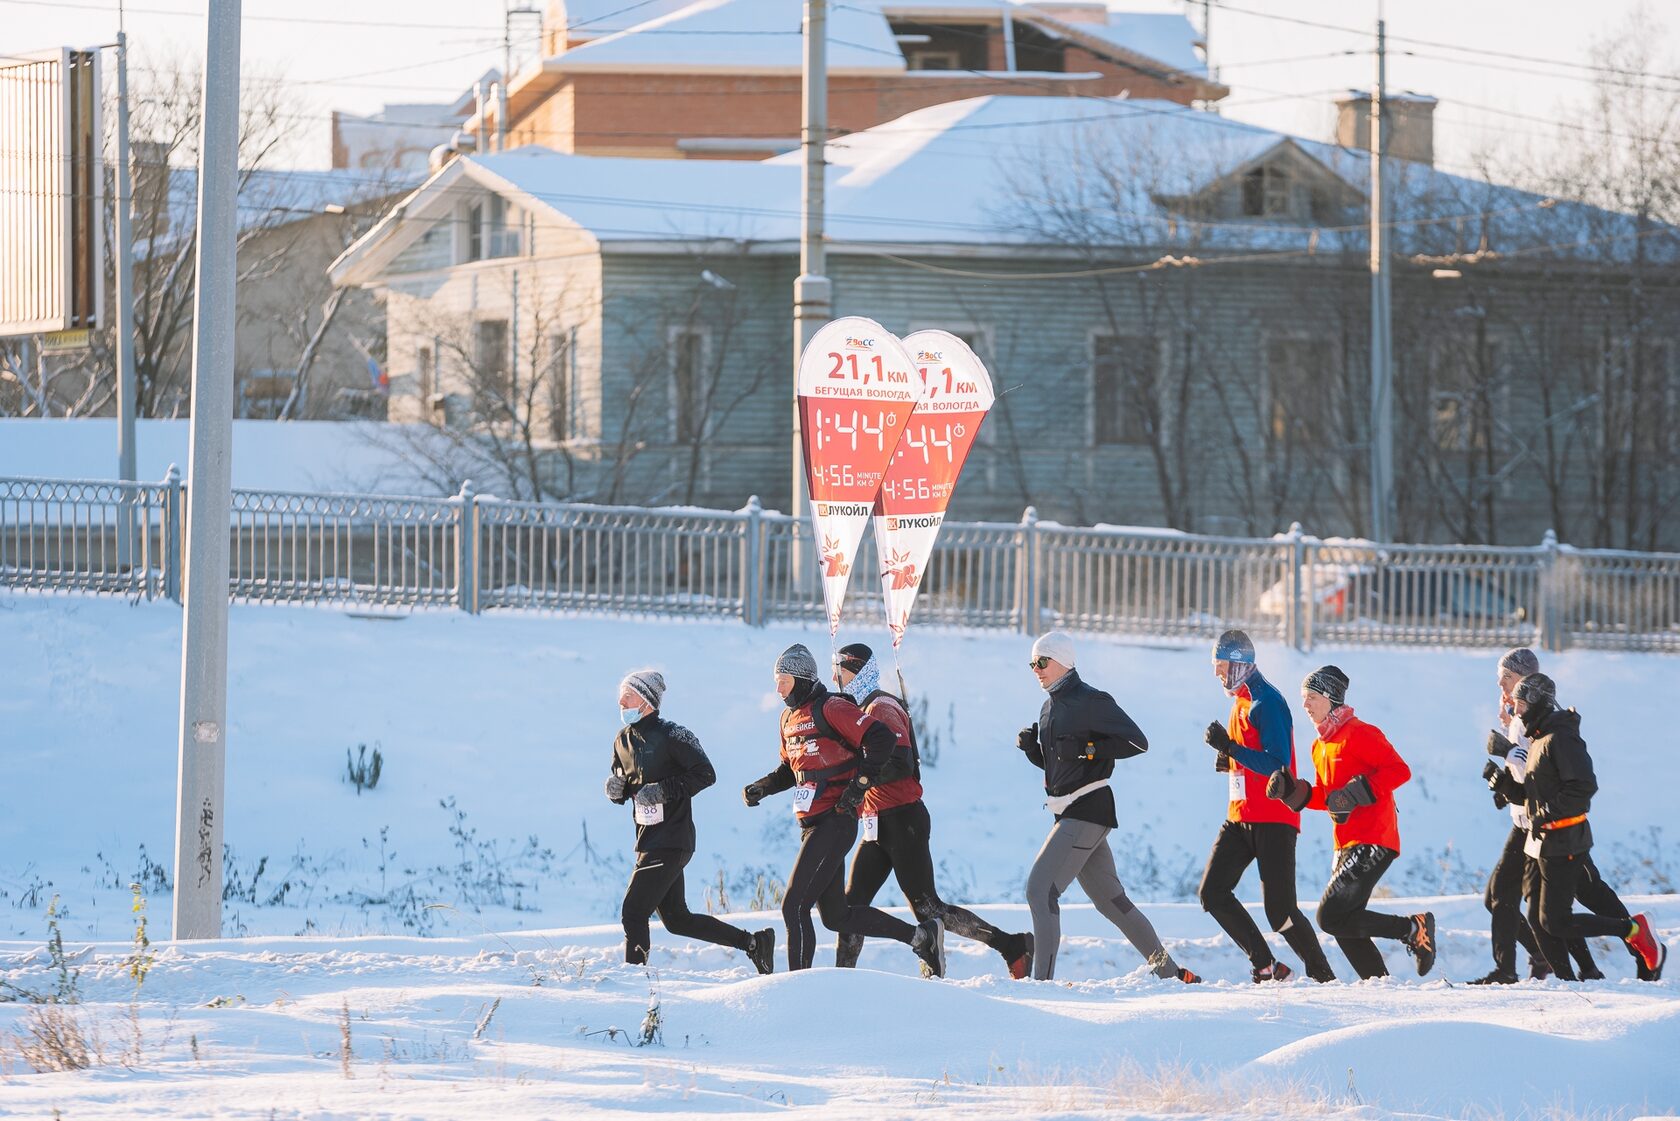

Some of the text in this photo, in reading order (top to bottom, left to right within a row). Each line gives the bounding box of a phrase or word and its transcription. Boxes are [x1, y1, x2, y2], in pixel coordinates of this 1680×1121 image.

[827, 352, 884, 385] 21,1
[920, 367, 953, 399] 1,1
[815, 386, 912, 400] БЕГУЩАЯ ВОЛОГДА
[932, 401, 980, 411] ВОЛОГДА
[815, 408, 884, 452] 1:44
[813, 464, 855, 487] 4:56
[856, 472, 882, 480] MINUTE
[883, 478, 930, 500] 4:56
[932, 482, 953, 491] MINUTE
[828, 503, 869, 517] ЛУКОЙЛ
[898, 516, 942, 529] ЛУКОЙЛ
